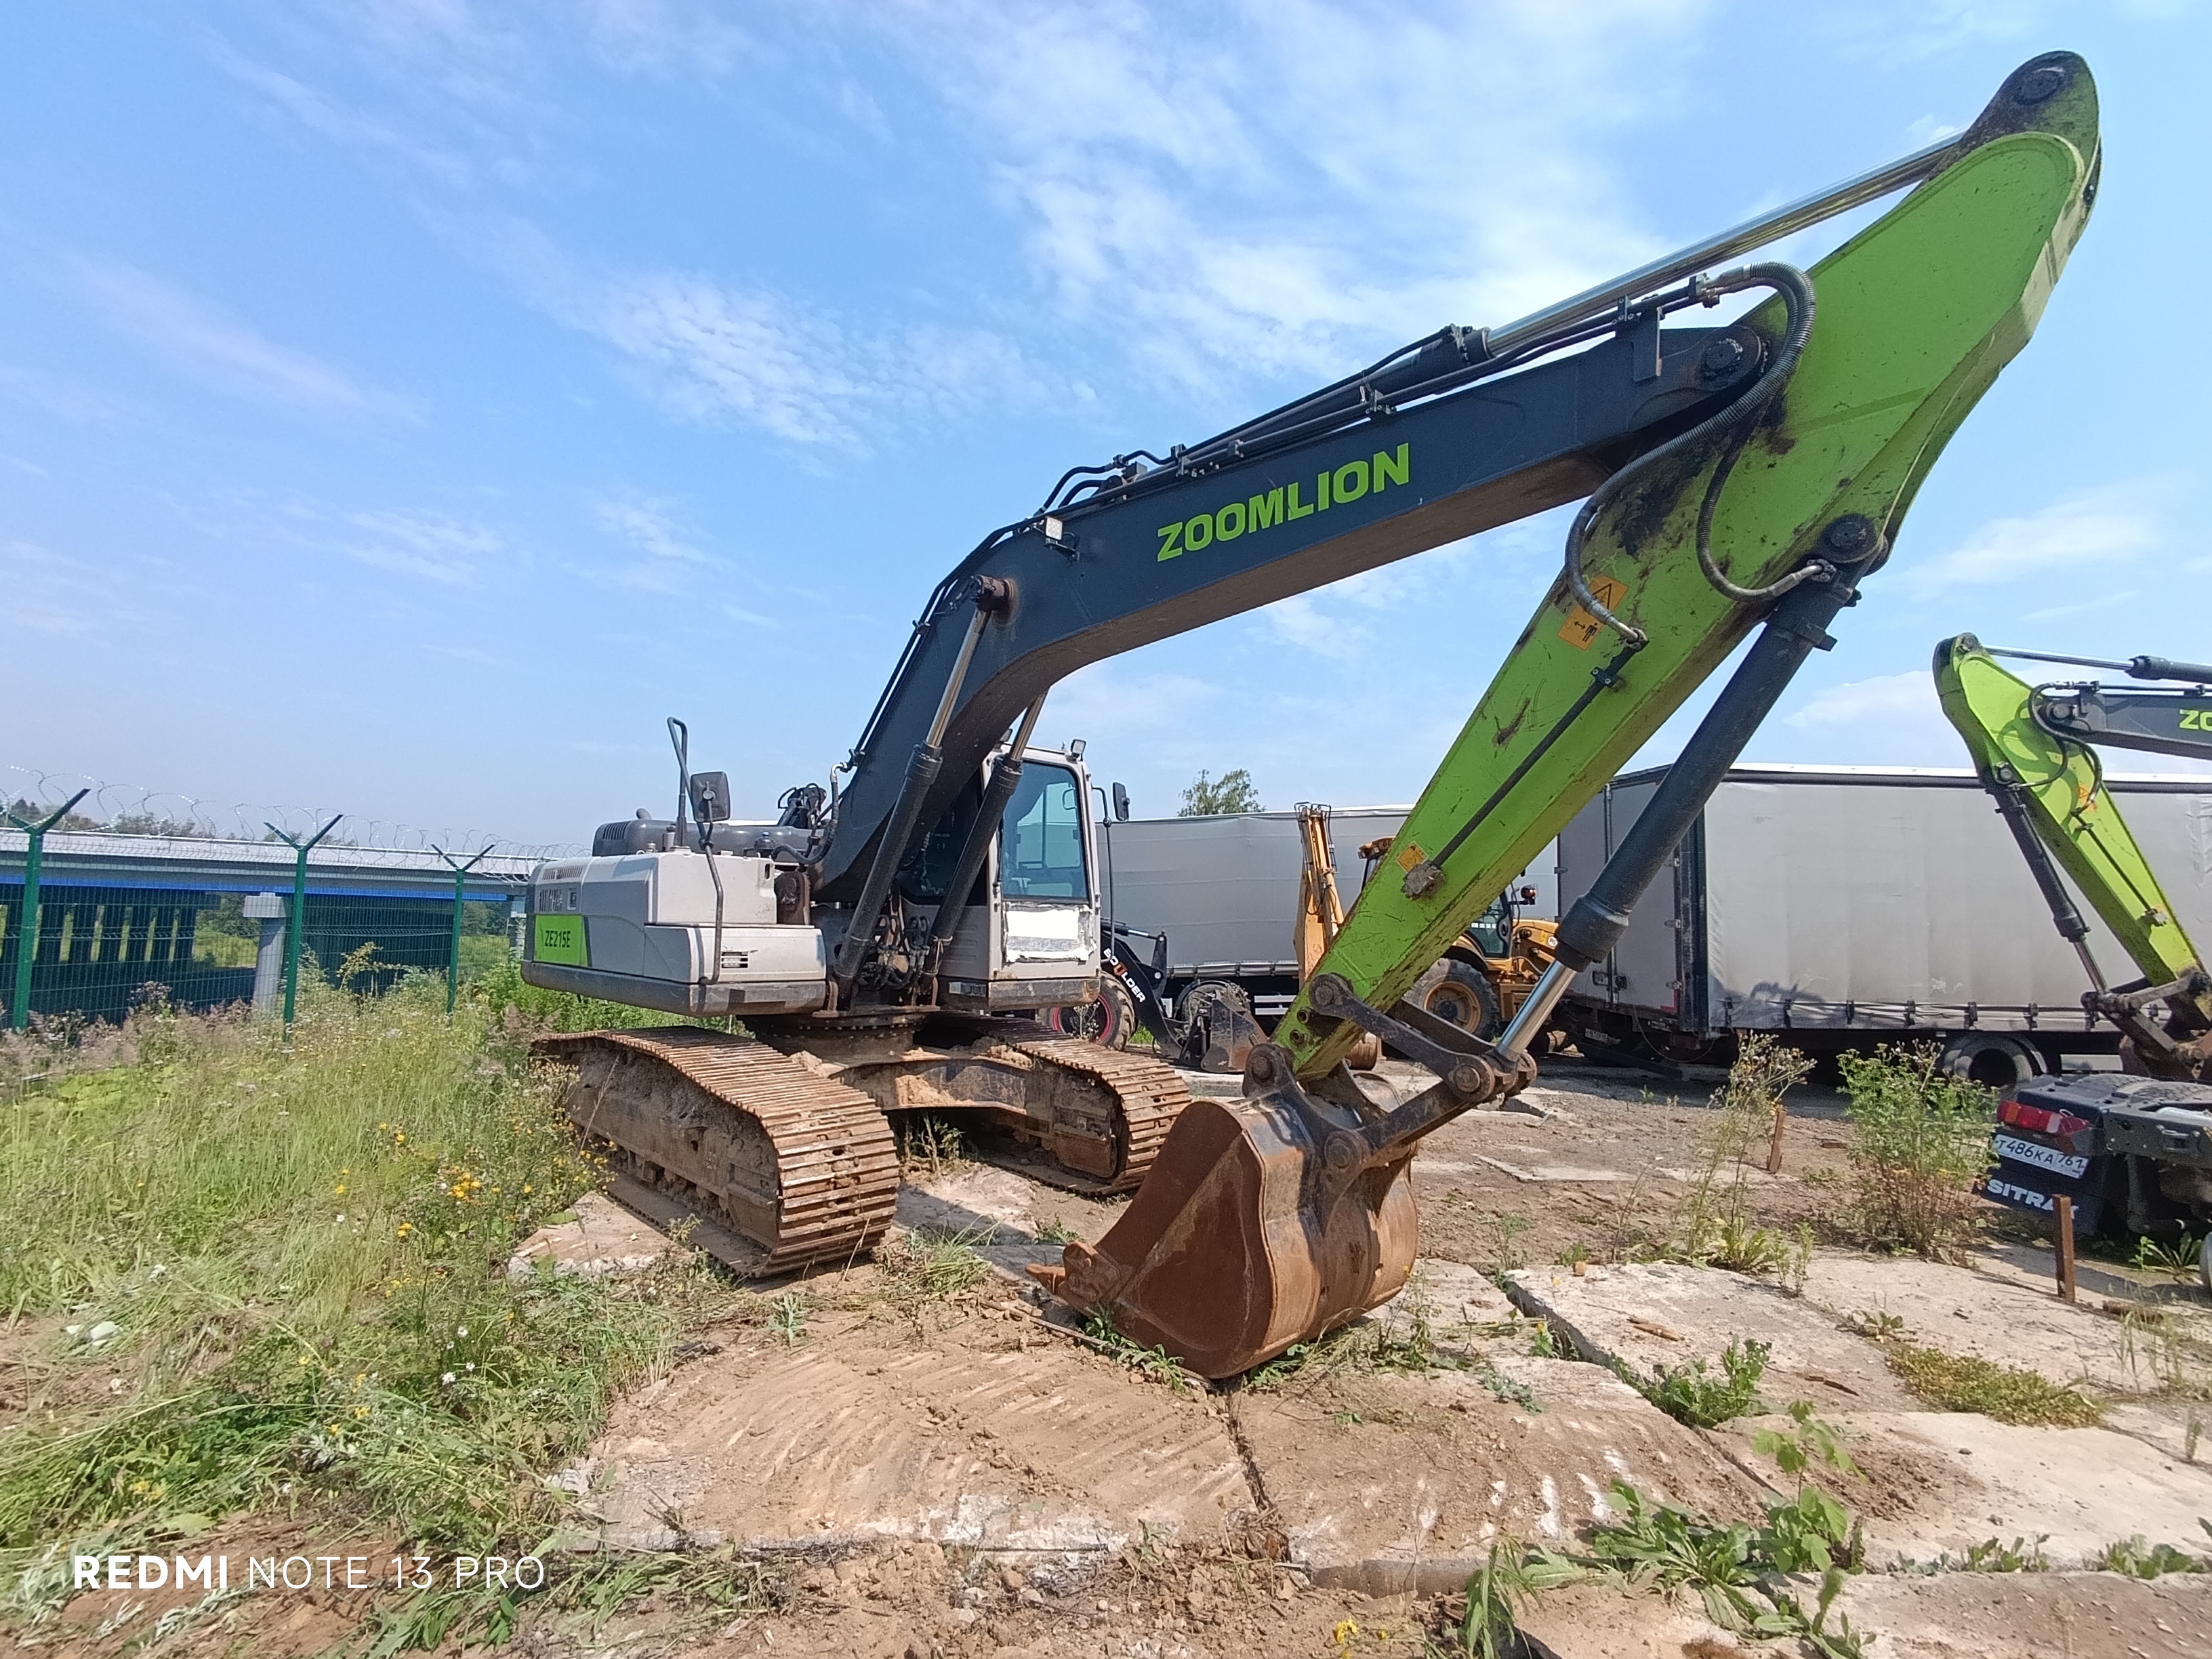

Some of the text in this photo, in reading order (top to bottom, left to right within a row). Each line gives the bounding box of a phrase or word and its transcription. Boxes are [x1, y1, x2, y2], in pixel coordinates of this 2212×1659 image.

[1157, 442, 1410, 562] ZOOMLION
[544, 930, 571, 948] ZE215E
[2057, 1153, 2084, 1169] 761
